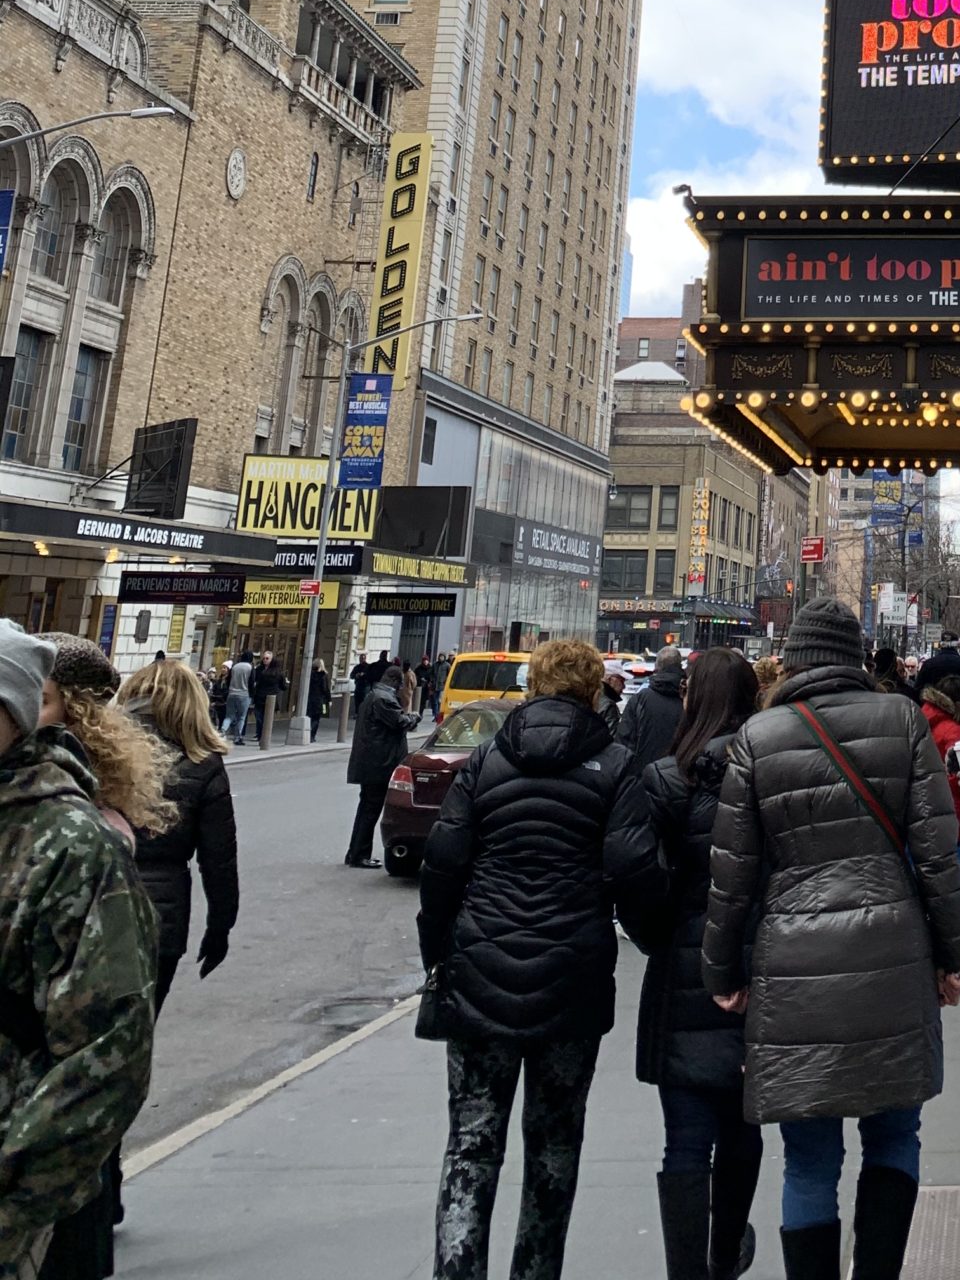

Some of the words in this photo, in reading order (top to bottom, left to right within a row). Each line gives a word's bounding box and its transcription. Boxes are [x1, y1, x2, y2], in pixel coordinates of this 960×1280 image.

[885, 54, 909, 63] THE
[916, 52, 945, 62] LIFE
[857, 67, 898, 88] THE
[372, 143, 422, 374] GOLDEN
[758, 251, 853, 282] ain't
[866, 252, 932, 282] too
[757, 295, 782, 304] THE
[789, 295, 818, 304] LIFE
[824, 295, 852, 304] AND
[859, 295, 899, 304] TIMES
[906, 294, 923, 303] OF
[929, 291, 959, 307] THE
[349, 401, 362, 410] BEST
[363, 401, 387, 410] MUSICAL
[345, 425, 384, 436] COME
[342, 446, 384, 457] AWAY
[248, 462, 295, 479] MARTIN
[241, 480, 374, 533] HANGMEN
[700, 478, 710, 520] IRON
[77, 519, 121, 540] BERNARD
[123, 527, 132, 540] B.
[134, 526, 168, 545] JACOBS
[170, 531, 204, 549] THEATRE
[698, 525, 708, 557] BAR
[532, 528, 550, 551] RETAIL
[550, 532, 567, 554] SPACE
[566, 537, 590, 559] AVAILABLE
[298, 552, 354, 567] ENGEMENT
[126, 577, 170, 592] PREVIEWS
[172, 578, 197, 592] BEGIN
[201, 579, 230, 593] MARCH
[232, 579, 239, 593] 2
[243, 592, 264, 605] BEGIN
[268, 592, 311, 605] FEBRUARY
[379, 599, 407, 611] NASTILY
[409, 599, 430, 611] GOOD
[624, 600, 657, 612] BAR
